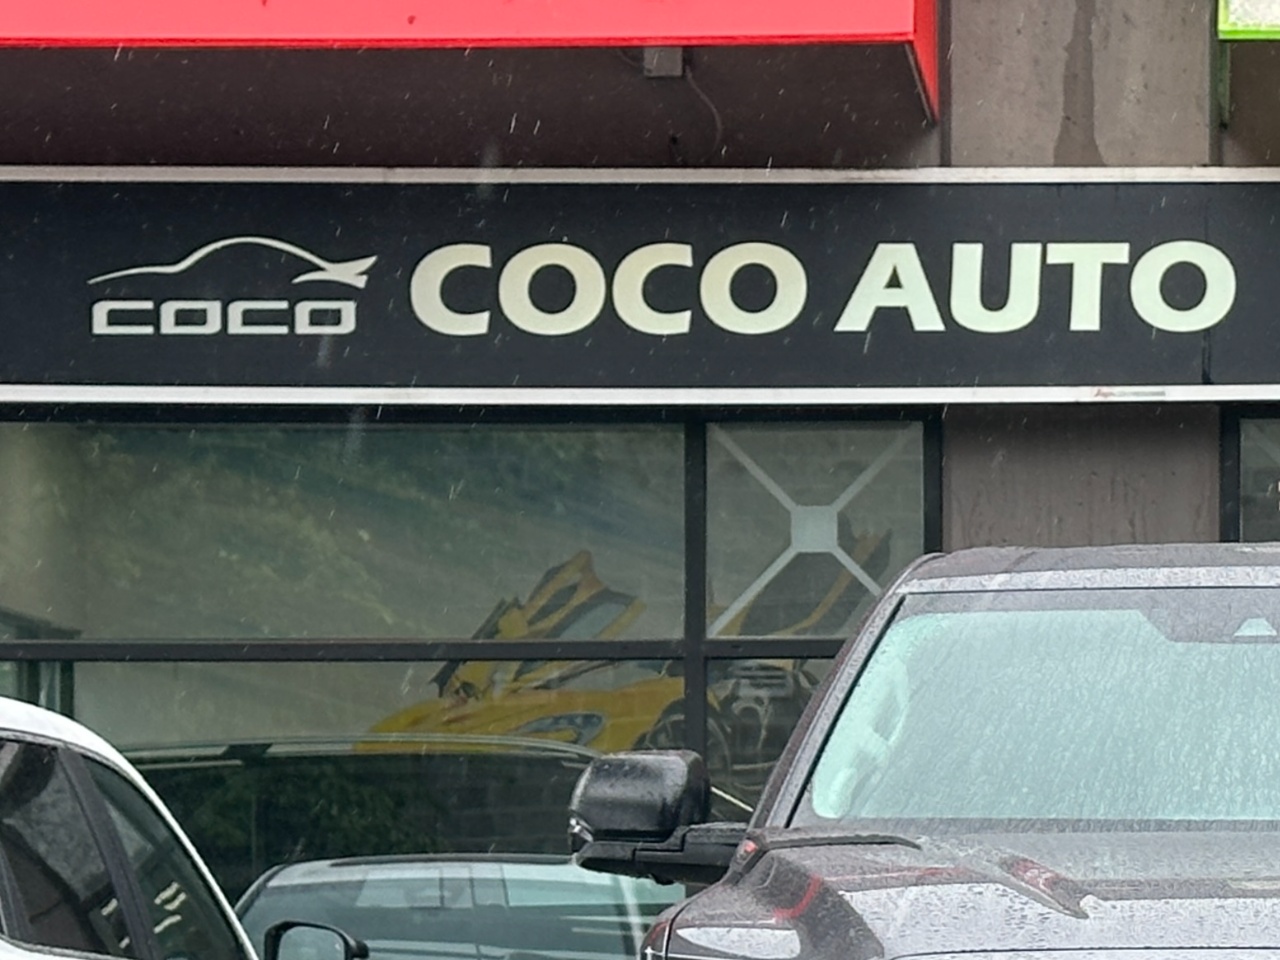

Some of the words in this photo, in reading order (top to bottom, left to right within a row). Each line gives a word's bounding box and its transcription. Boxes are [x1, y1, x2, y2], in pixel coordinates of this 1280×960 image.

[91, 299, 357, 335] COCO
[410, 241, 808, 336] COCO
[833, 240, 1237, 333] AUTO
